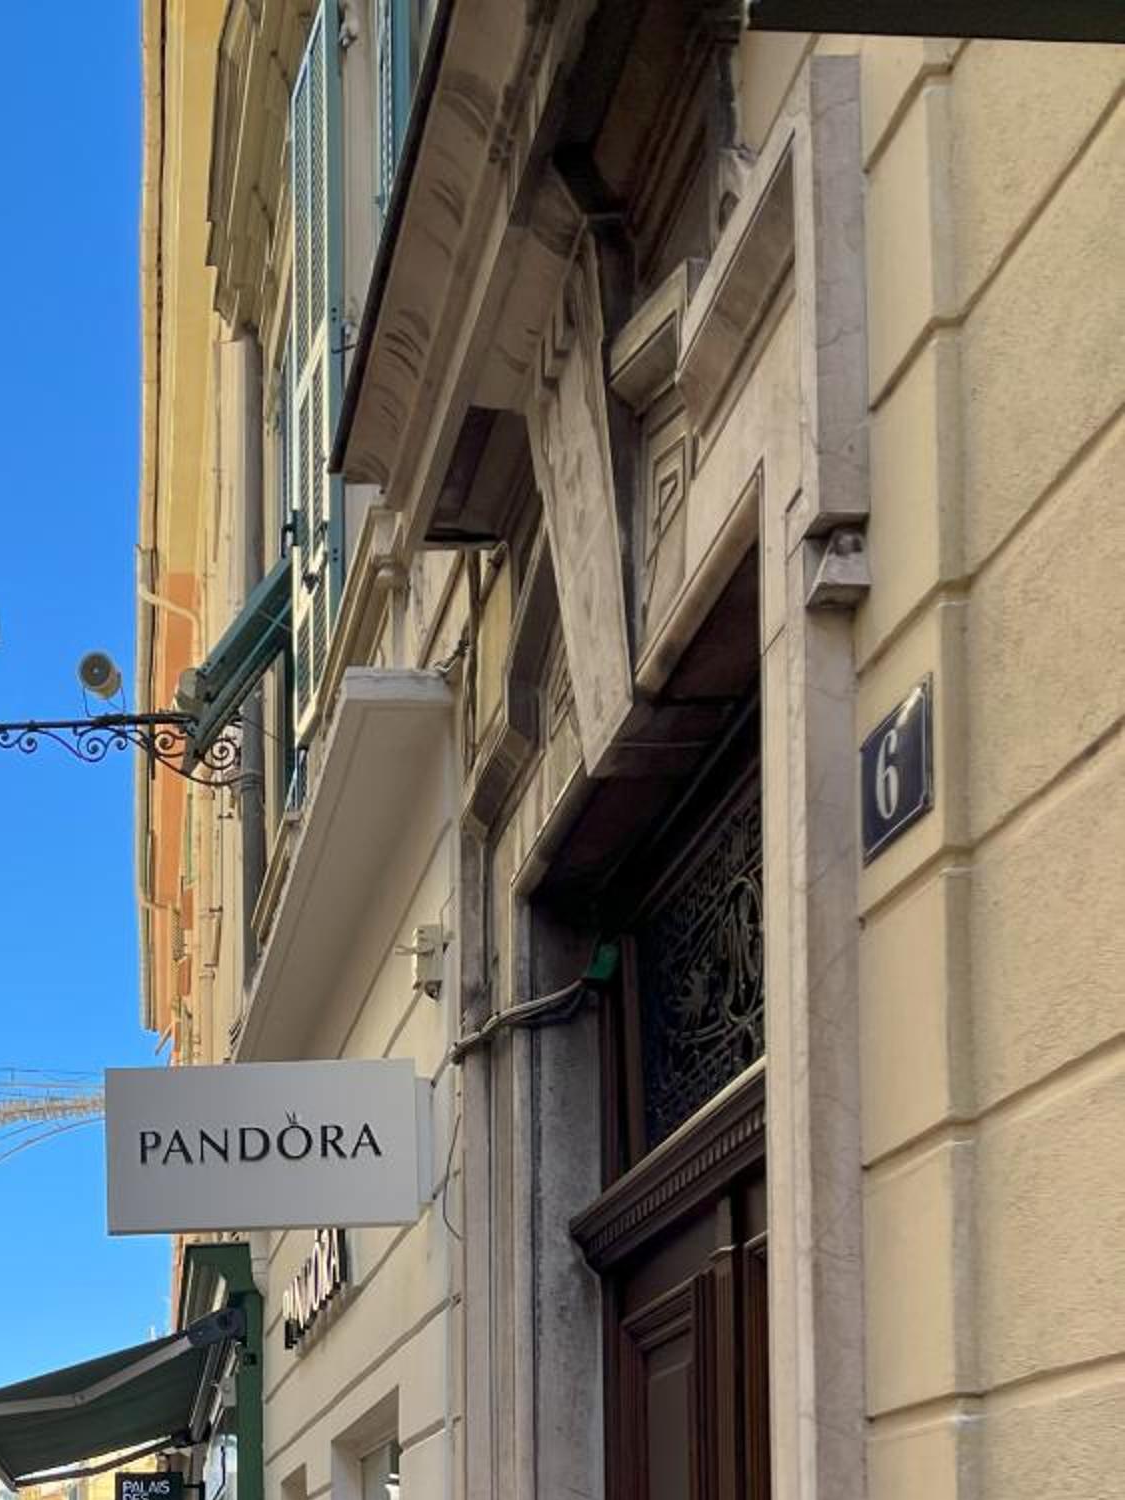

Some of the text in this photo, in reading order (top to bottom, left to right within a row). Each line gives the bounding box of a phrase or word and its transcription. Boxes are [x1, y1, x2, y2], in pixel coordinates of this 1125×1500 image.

[875, 729, 900, 820] 6
[139, 1113, 382, 1164] PANDORA
[122, 1480, 171, 1494] PALAIS
